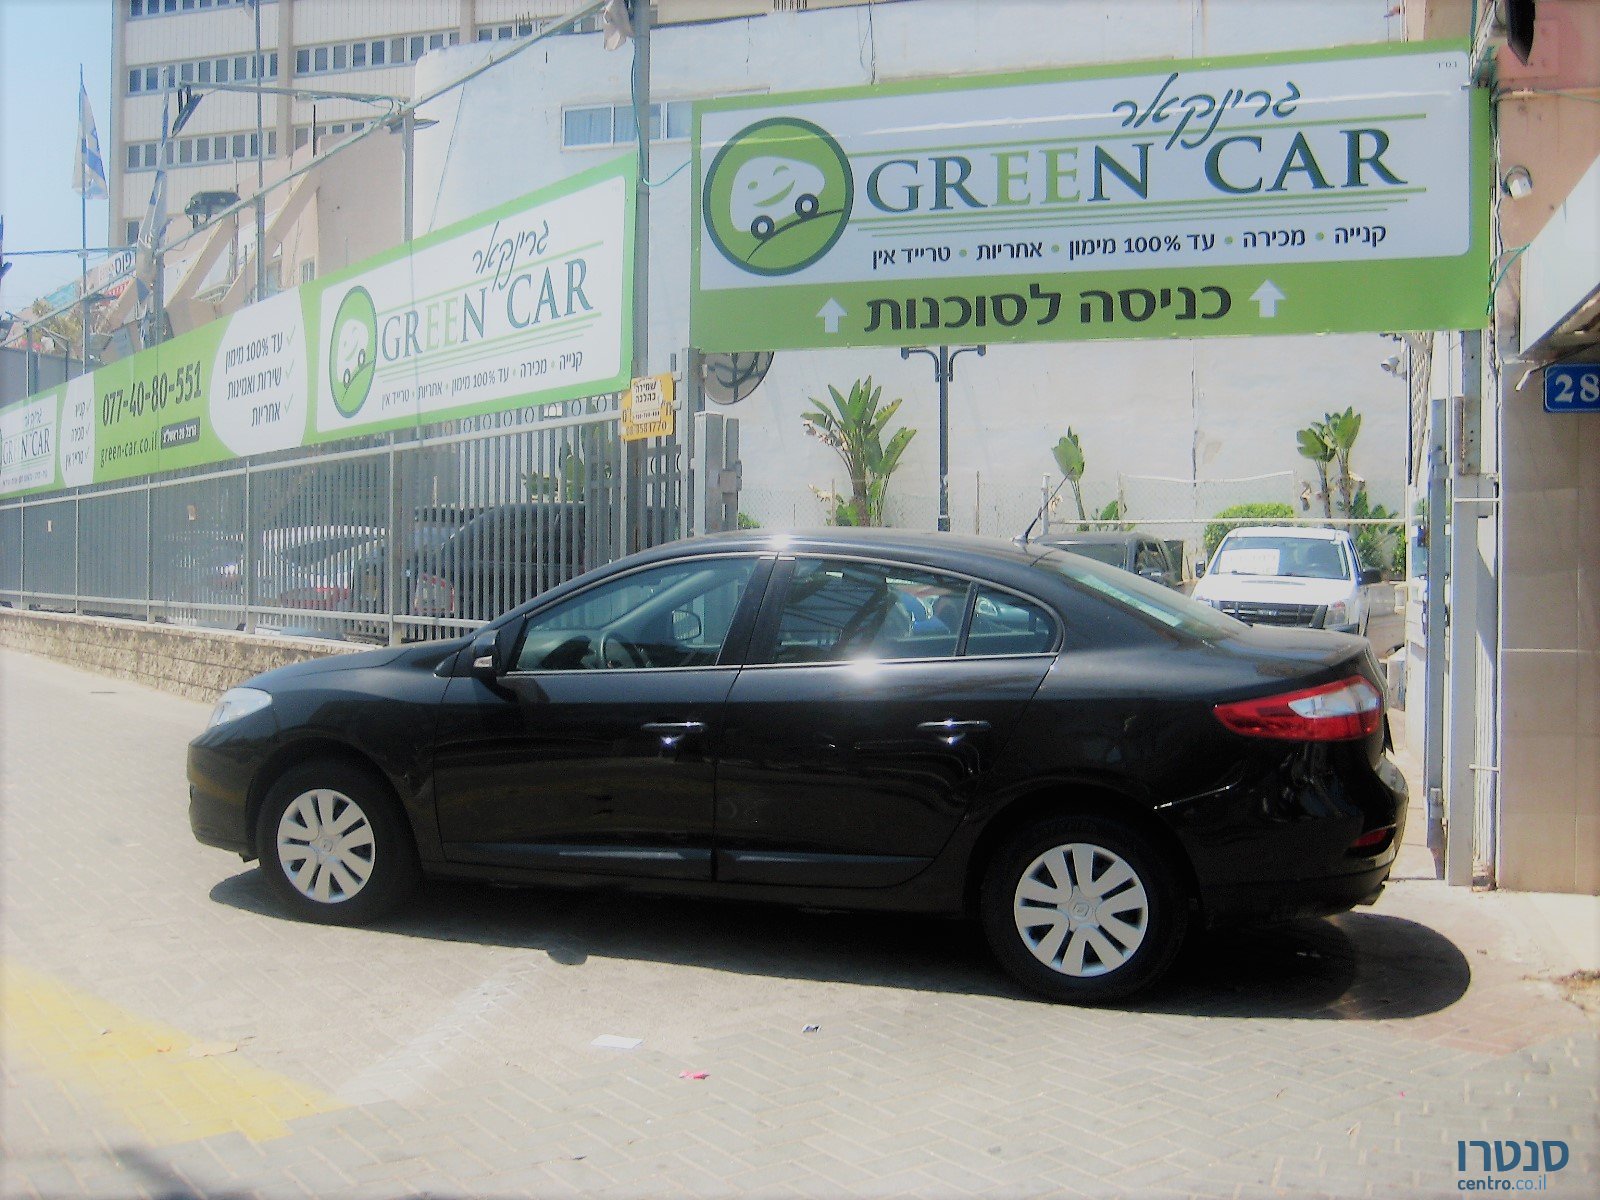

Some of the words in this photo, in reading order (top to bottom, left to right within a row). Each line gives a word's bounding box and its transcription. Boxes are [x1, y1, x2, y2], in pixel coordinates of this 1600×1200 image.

[1112, 72, 1300, 150] גרינקאר
[866, 142, 1155, 213] GREEN
[1204, 128, 1408, 195] CAR
[1124, 235, 1181, 254] 100%
[1187, 233, 1215, 252] עד
[1243, 229, 1306, 248] מכירה
[1334, 225, 1387, 247] קנייה
[472, 220, 550, 292] גרינקאר
[872, 249, 896, 270] אין
[901, 246, 951, 264] טרייד
[976, 242, 1043, 261] אחריות
[1069, 238, 1117, 260] מימון
[381, 286, 488, 361] GREEN
[506, 258, 594, 329] CAR
[864, 283, 1062, 332] לסוכנות
[1080, 285, 1232, 323] כניסה
[246, 337, 269, 362] 100%
[271, 332, 283, 354] עד
[225, 346, 244, 375] מימון
[520, 358, 547, 379] מכירה
[559, 351, 583, 372] קנייה
[257, 366, 282, 393] שירות
[473, 372, 496, 388] 100%
[498, 366, 510, 383] עד
[102, 360, 202, 427] 077-40-80-551
[228, 374, 256, 400] ואמינות
[392, 388, 410, 404] טרייד
[418, 381, 443, 400] אחריות
[451, 377, 471, 397] מימון
[1555, 373, 1600, 403] 28
[381, 393, 391, 411] אין
[252, 402, 281, 427] אחריות
[32, 428, 50, 456] CAR
[100, 430, 158, 468] green-car.co.il
